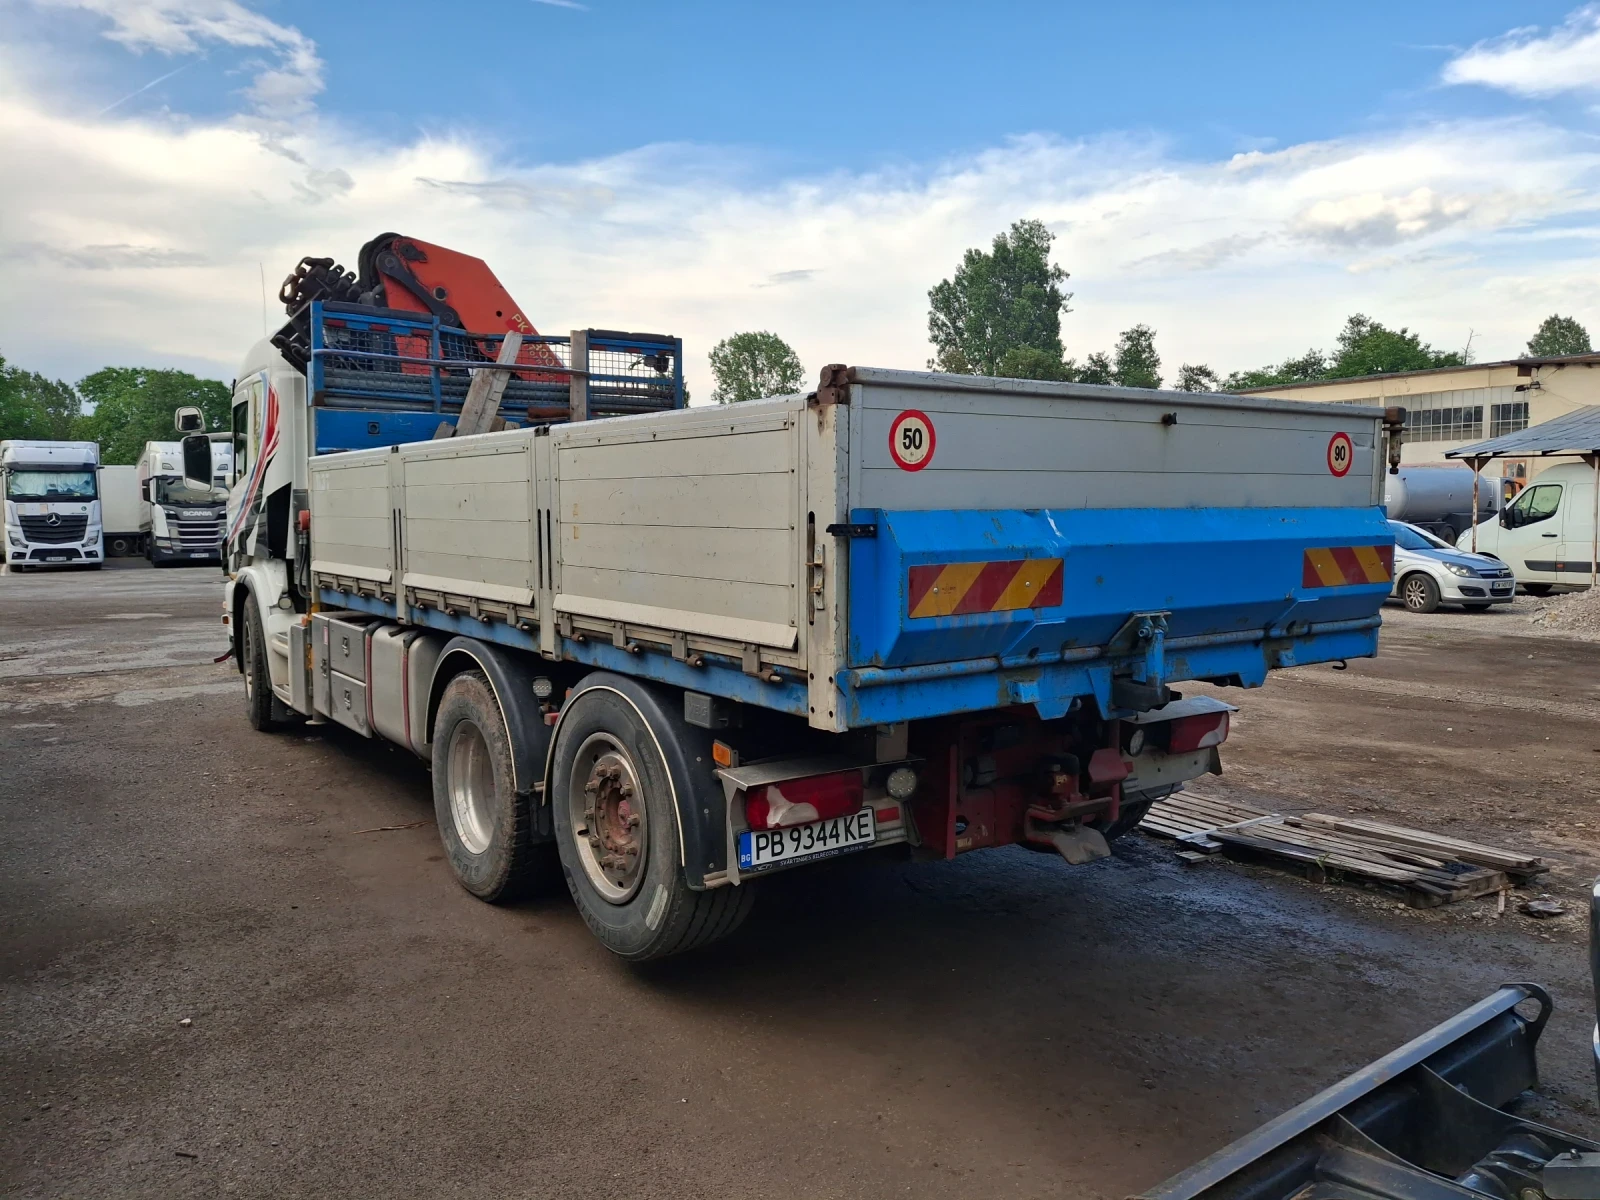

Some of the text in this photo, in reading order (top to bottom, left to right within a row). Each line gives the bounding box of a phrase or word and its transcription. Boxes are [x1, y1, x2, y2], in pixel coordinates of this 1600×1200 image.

[511, 313, 529, 332] PK
[902, 428, 922, 450] 50
[1334, 445, 1346, 461] 90
[755, 813, 871, 860] PB 9344 KE
[741, 853, 751, 863] BG
